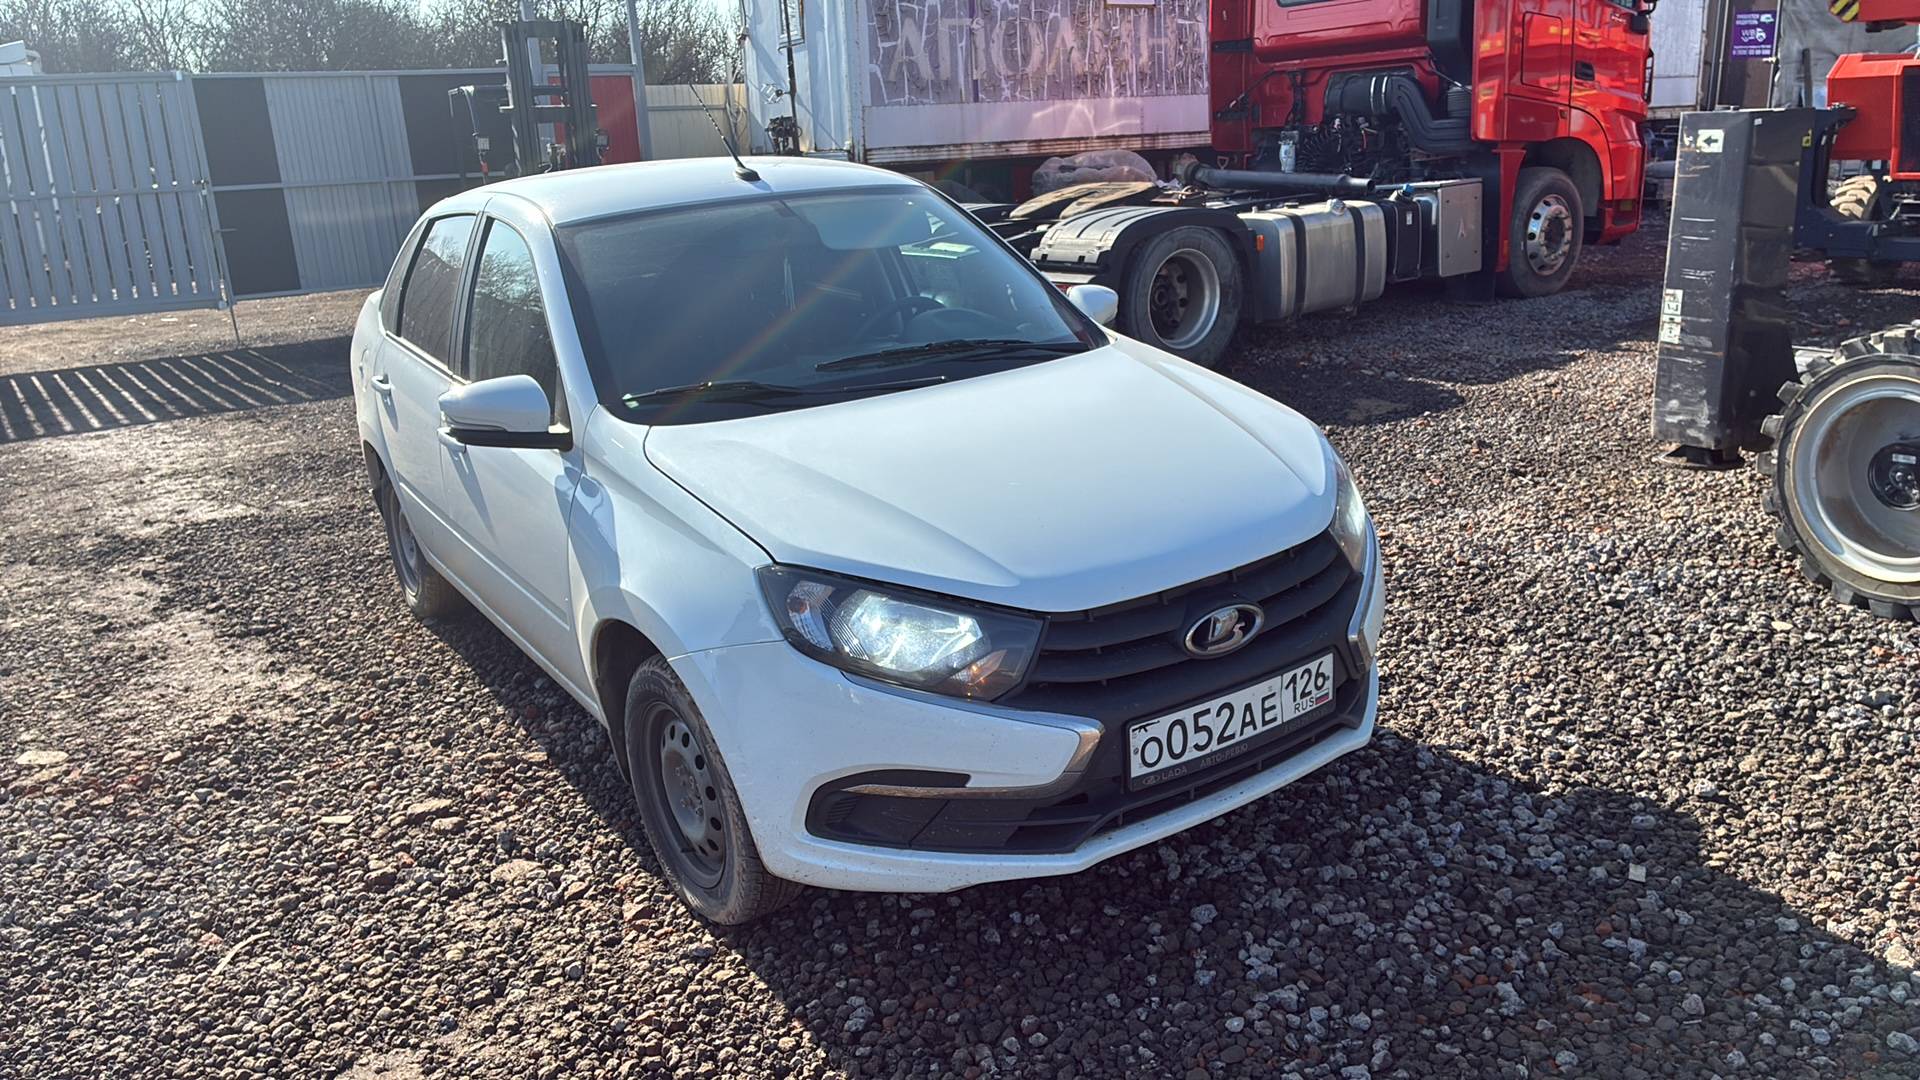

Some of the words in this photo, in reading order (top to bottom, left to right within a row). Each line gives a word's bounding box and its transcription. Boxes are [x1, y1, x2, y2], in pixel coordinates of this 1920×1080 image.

[1284, 661, 1326, 702] 126
[1294, 697, 1315, 714] RUS
[1161, 766, 1188, 780] LADA
